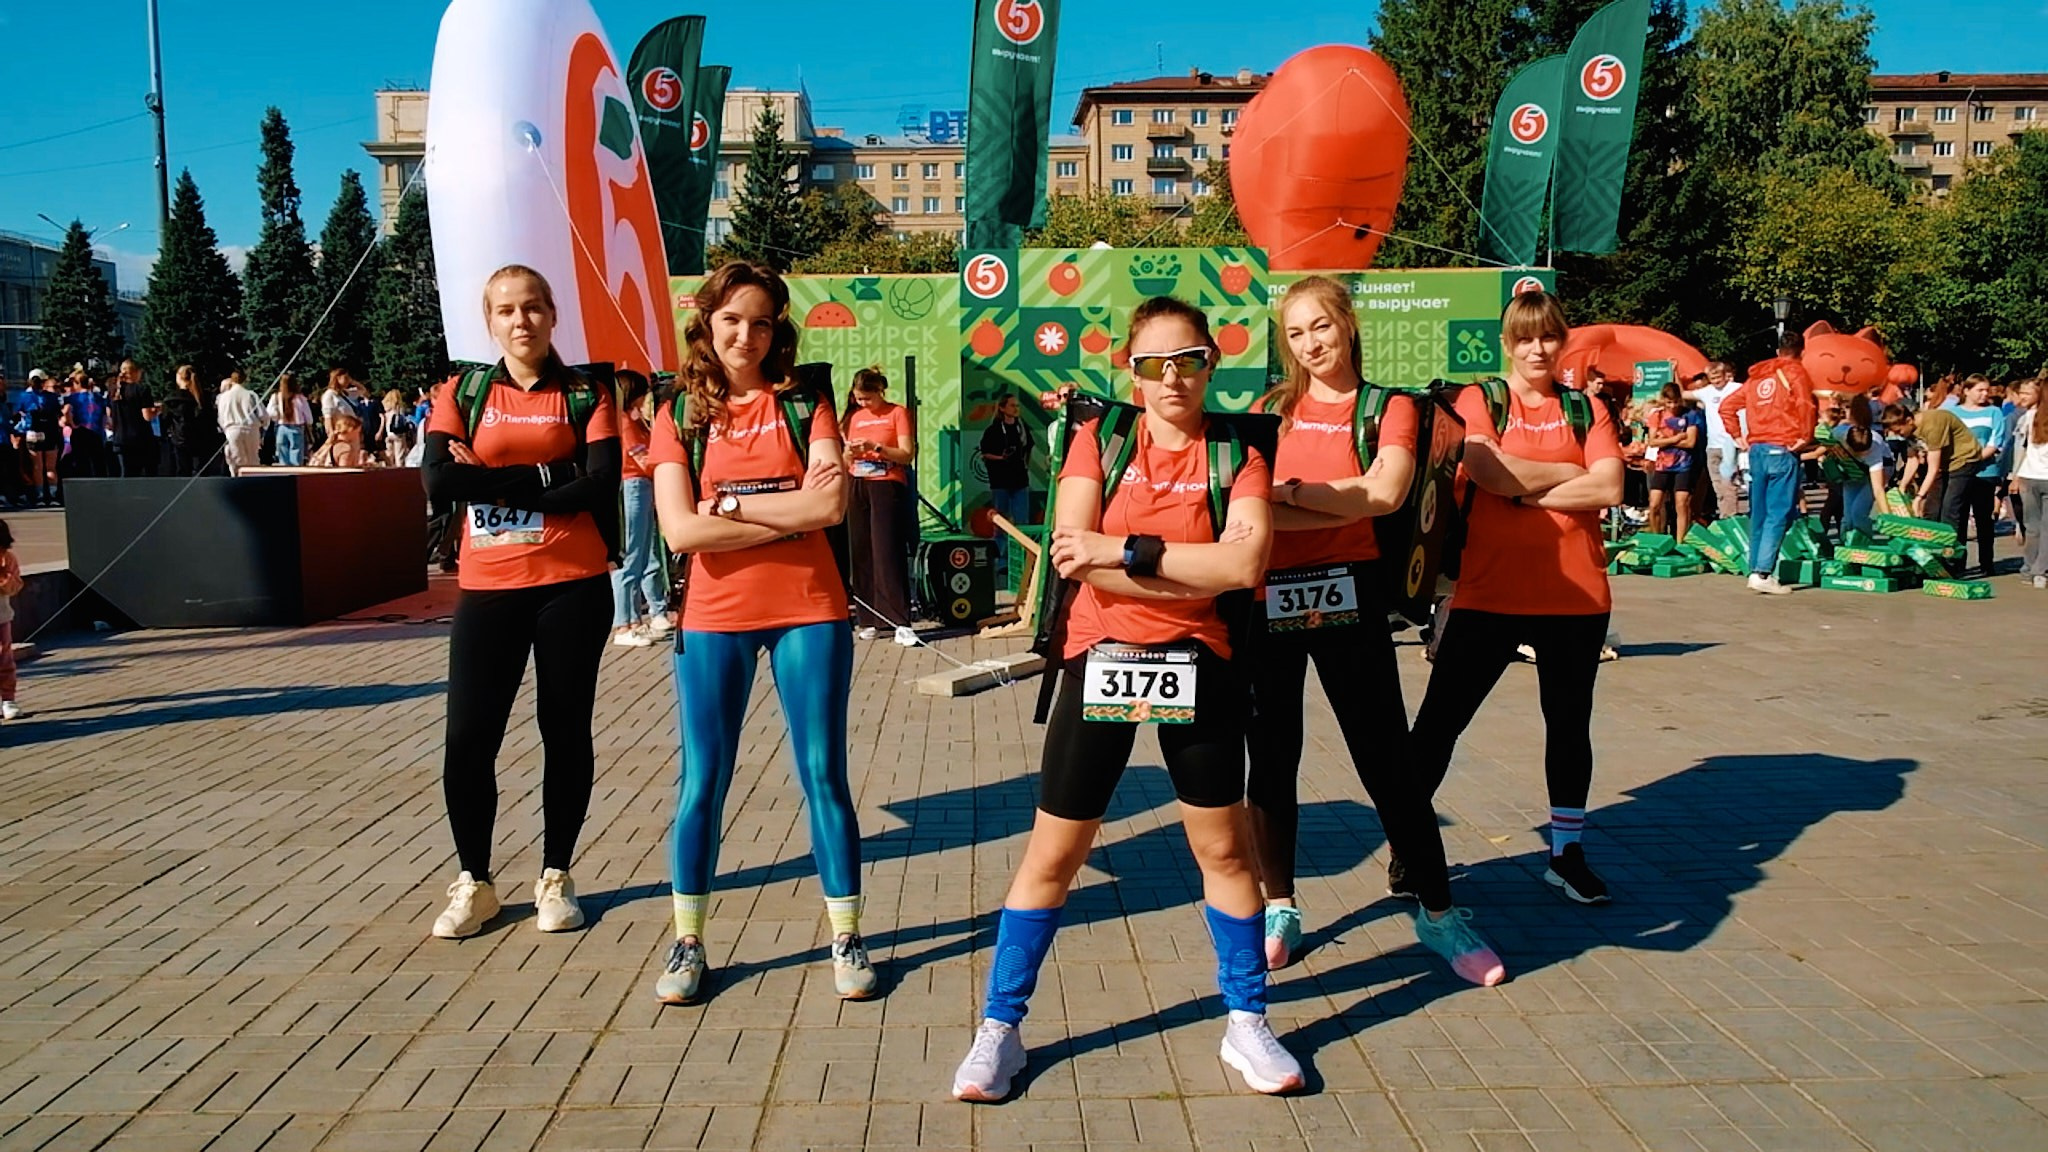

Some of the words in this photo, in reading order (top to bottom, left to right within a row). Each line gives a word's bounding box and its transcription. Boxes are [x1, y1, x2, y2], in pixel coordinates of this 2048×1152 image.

[1007, 0, 1034, 34] 5
[653, 71, 676, 104] 5
[1590, 59, 1616, 92] 5
[1518, 109, 1542, 137] 5
[975, 258, 999, 291] 5
[1368, 298, 1450, 312] выручает
[806, 325, 938, 346] СИБИРСК
[474, 508, 533, 528] 8647
[1278, 584, 1343, 612] 3176
[1101, 670, 1179, 699] 3178
